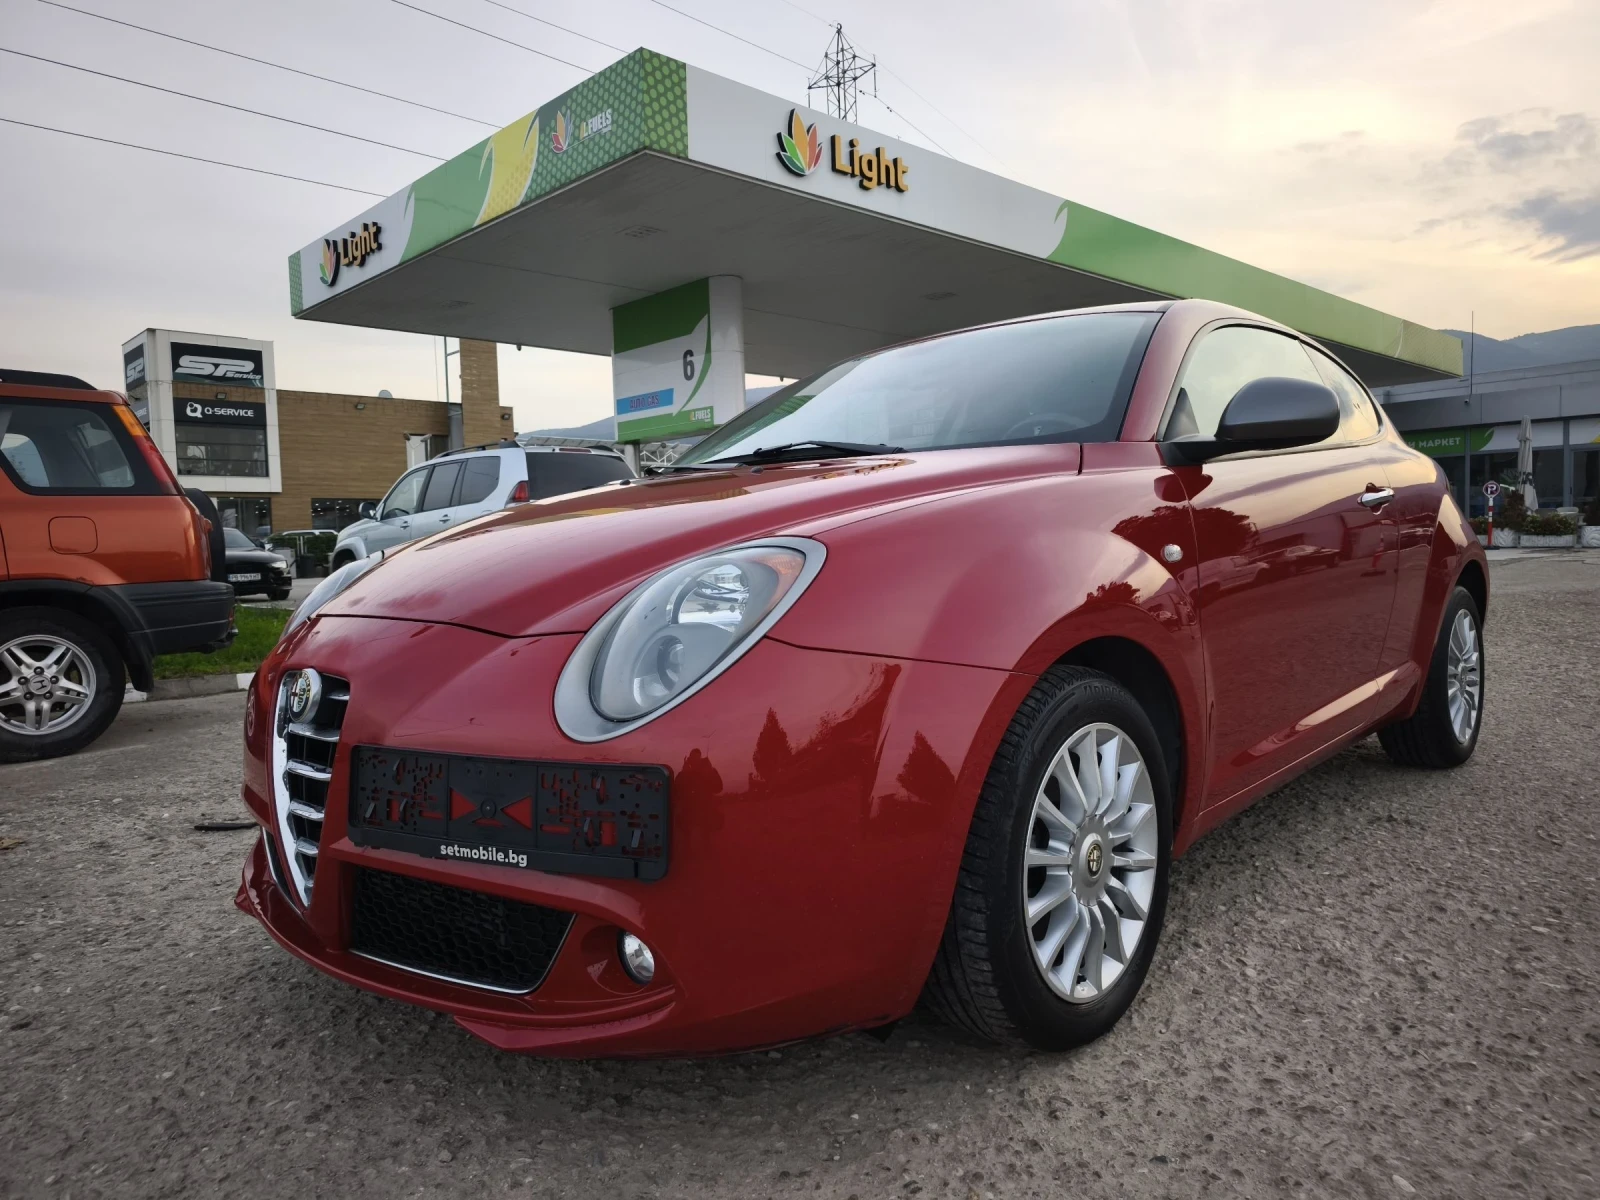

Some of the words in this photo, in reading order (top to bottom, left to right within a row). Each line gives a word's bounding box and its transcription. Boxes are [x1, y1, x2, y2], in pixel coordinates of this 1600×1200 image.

[831, 134, 909, 192] Light
[341, 222, 382, 267] Light
[174, 355, 255, 377] SP
[225, 371, 262, 380] Service
[682, 349, 695, 381] 6
[204, 406, 254, 417] Q-SERVICE
[630, 398, 645, 409] AUTO
[647, 394, 660, 407] GAS
[1419, 437, 1460, 449] МАРКЕТ
[440, 844, 528, 867] setmobile.bg
